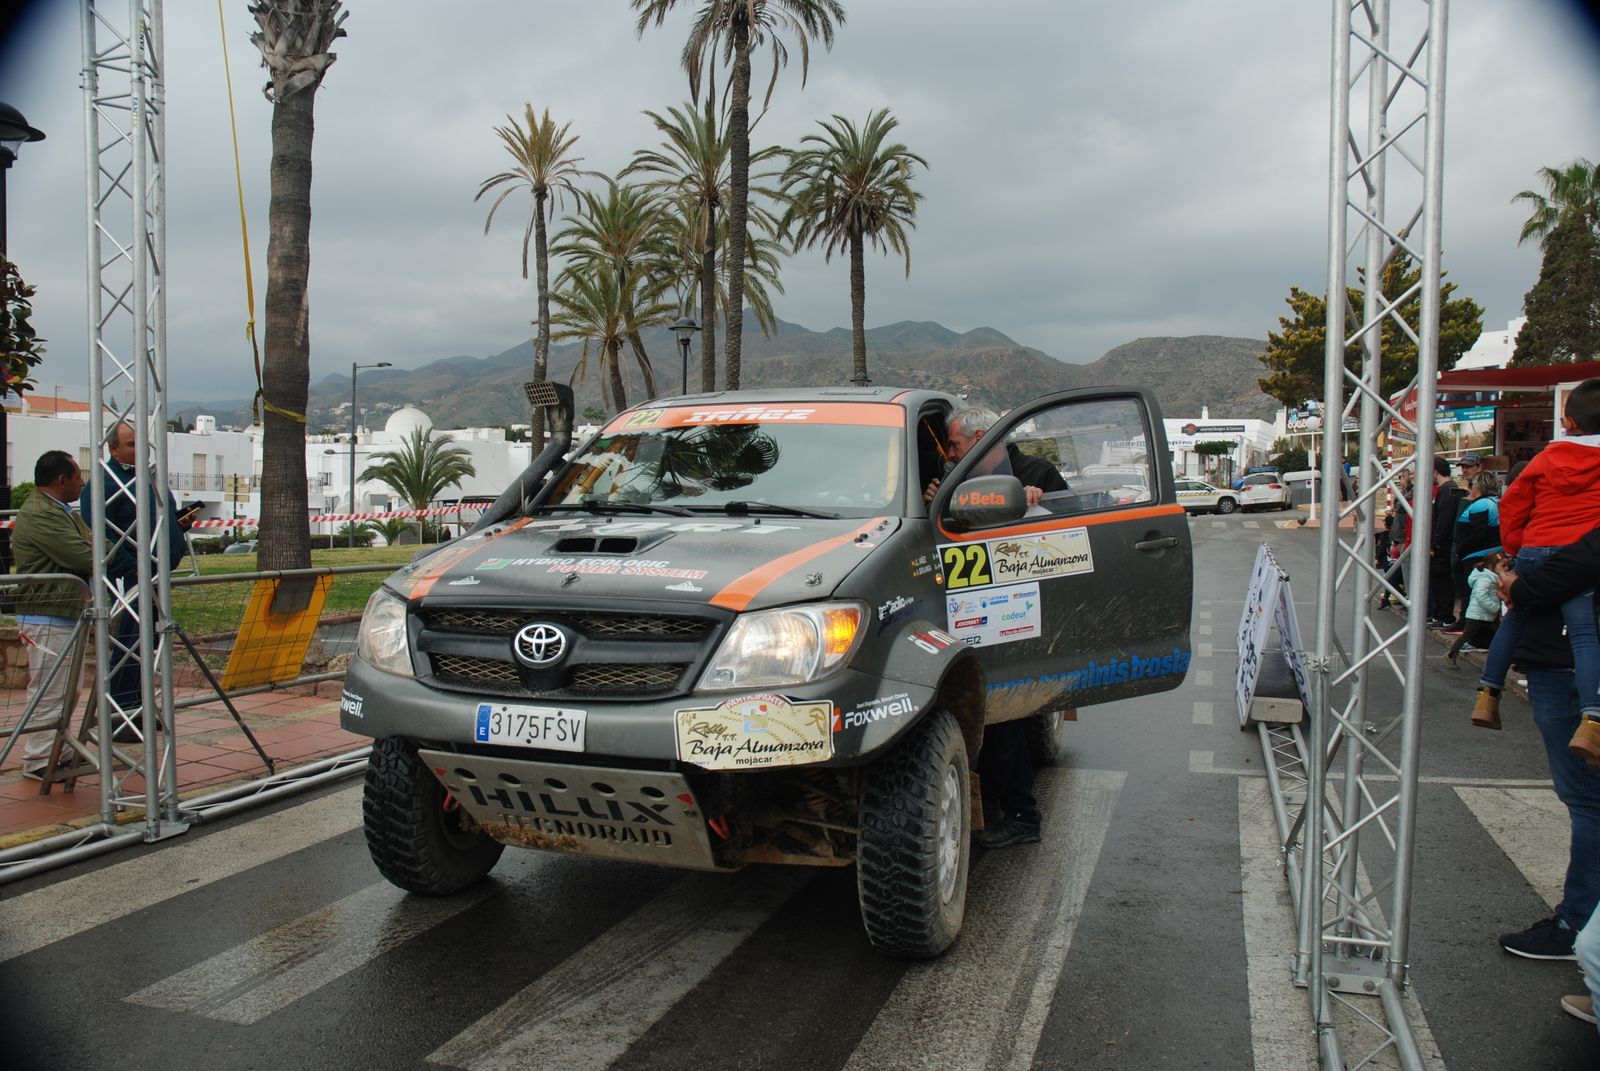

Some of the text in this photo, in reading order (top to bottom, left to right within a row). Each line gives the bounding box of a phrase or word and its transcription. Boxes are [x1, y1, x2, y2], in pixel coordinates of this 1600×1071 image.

[627, 410, 661, 428] 22
[994, 542, 1022, 558] Rally
[512, 557, 671, 569] HYDRO ECOLOGIC
[547, 564, 708, 579] POWER SYSTEM
[944, 544, 991, 589] 22
[994, 552, 1089, 577] Baja Almanzora
[1001, 609, 1027, 621] codeur
[725, 693, 785, 709] PARTICIPANTE
[479, 726, 486, 735] E
[490, 712, 581, 743] 3175FSV
[687, 721, 729, 741] Rally
[685, 737, 824, 762] Baja Almanzora
[467, 785, 675, 826] HILUX
[497, 812, 674, 848] TECNORAID
